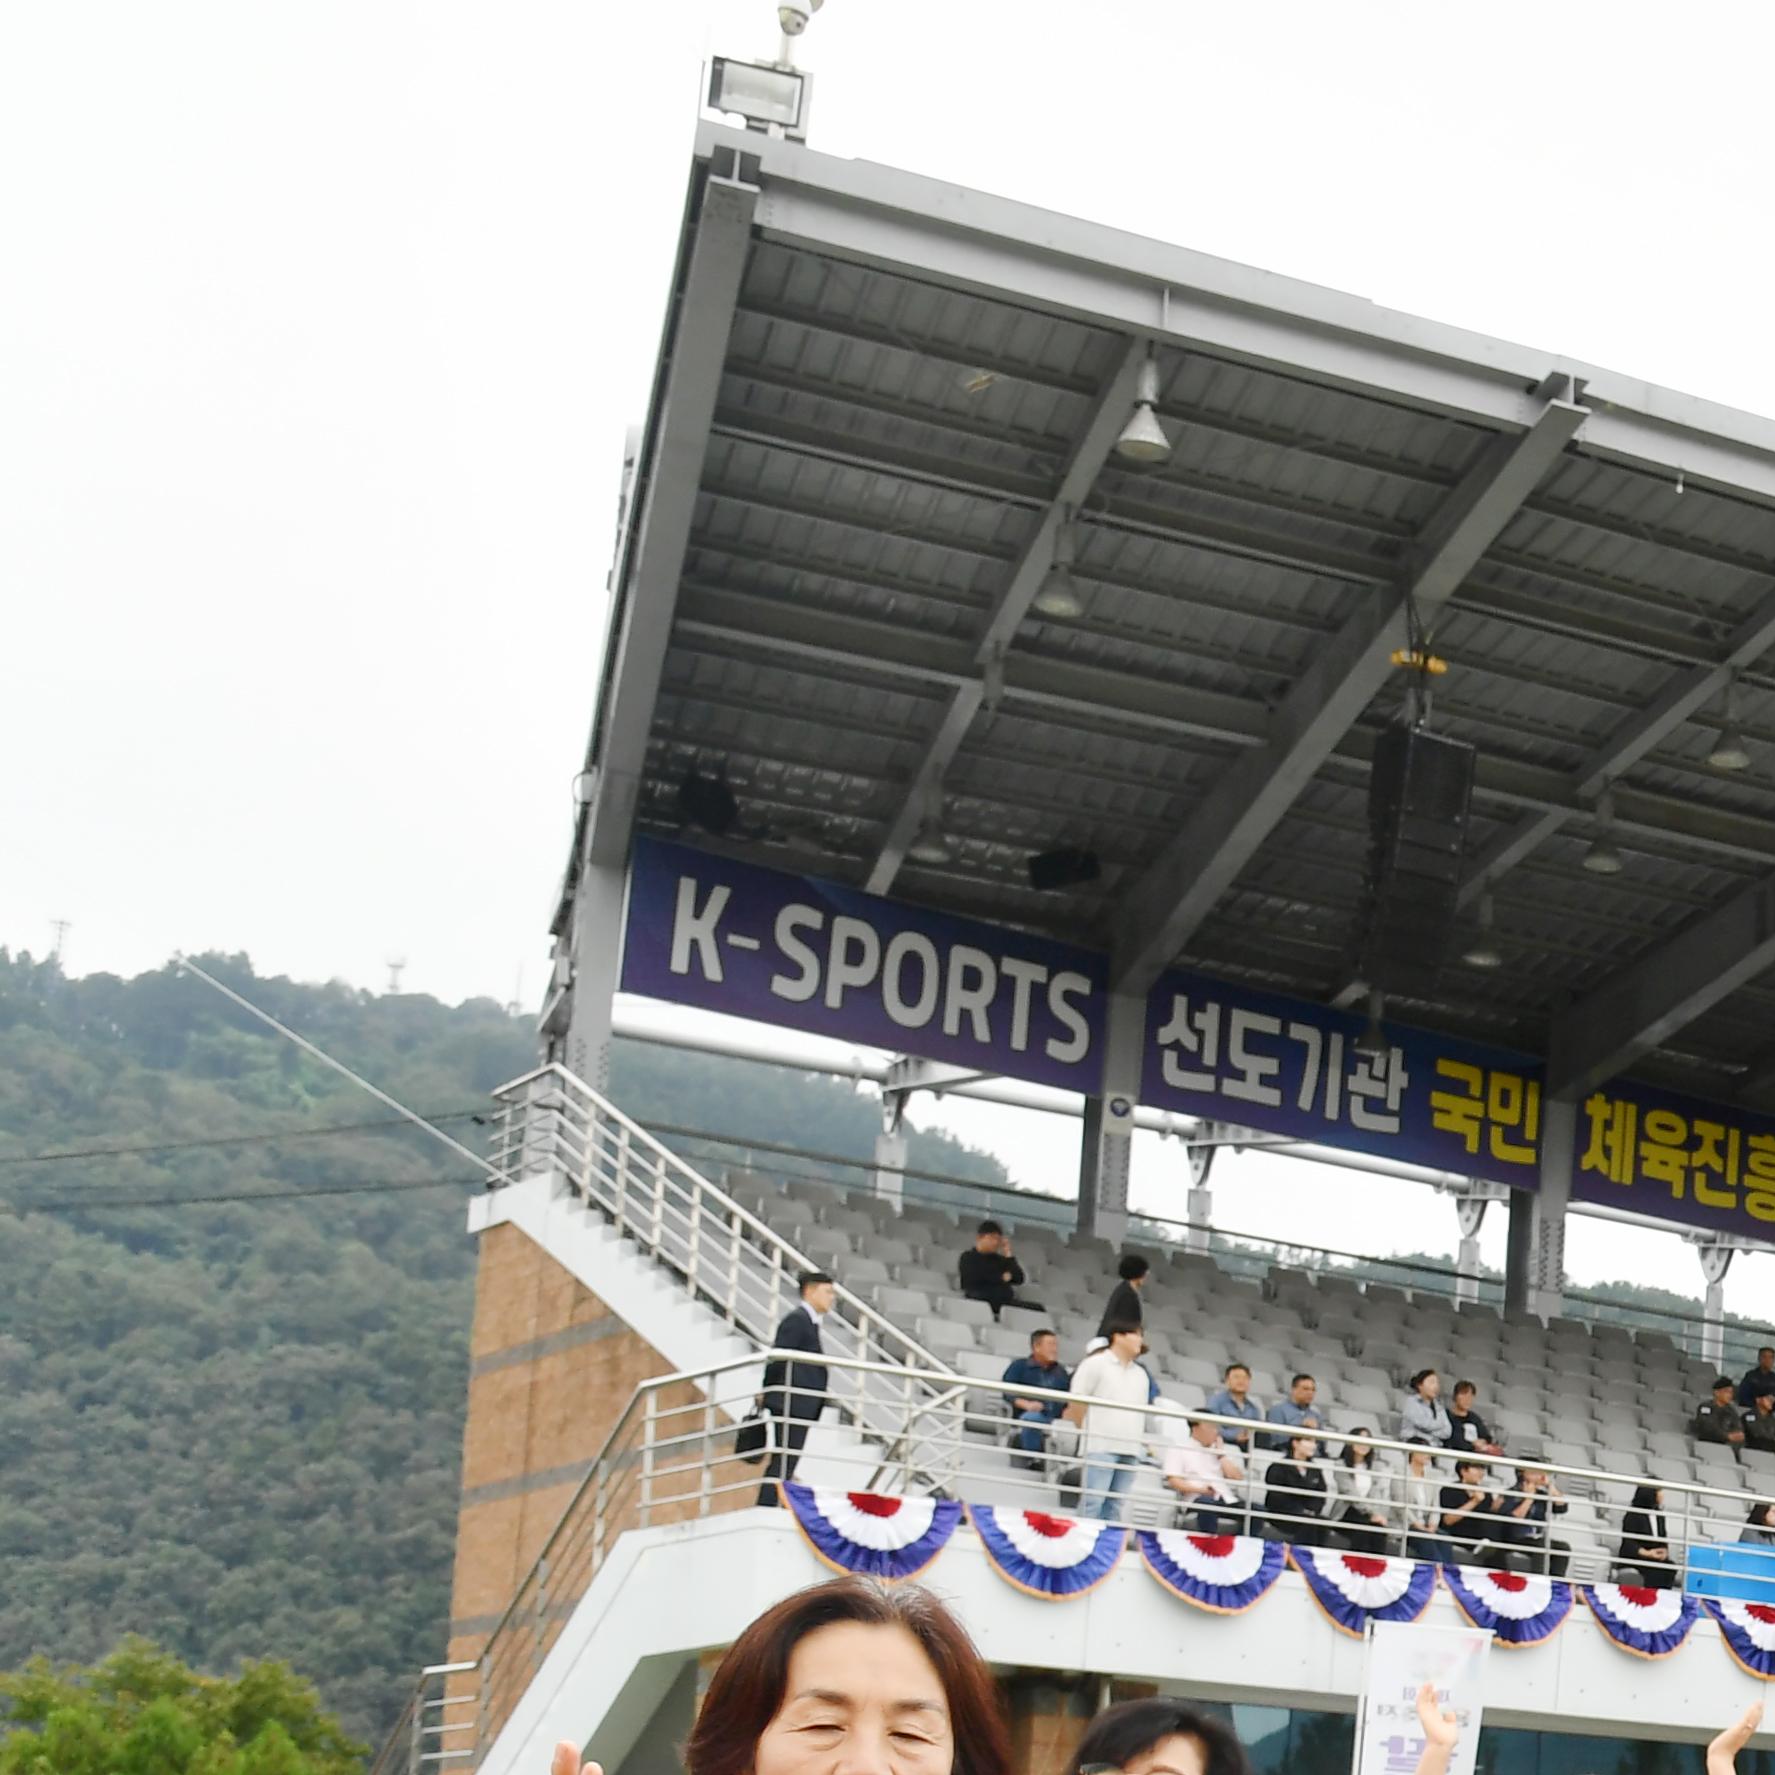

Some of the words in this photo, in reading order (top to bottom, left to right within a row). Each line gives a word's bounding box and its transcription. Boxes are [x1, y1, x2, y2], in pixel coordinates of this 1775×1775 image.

[669, 876, 1093, 1065] K-SPORTS
[1156, 994, 1409, 1135] 선도기관
[1430, 1057, 1541, 1165] 국민
